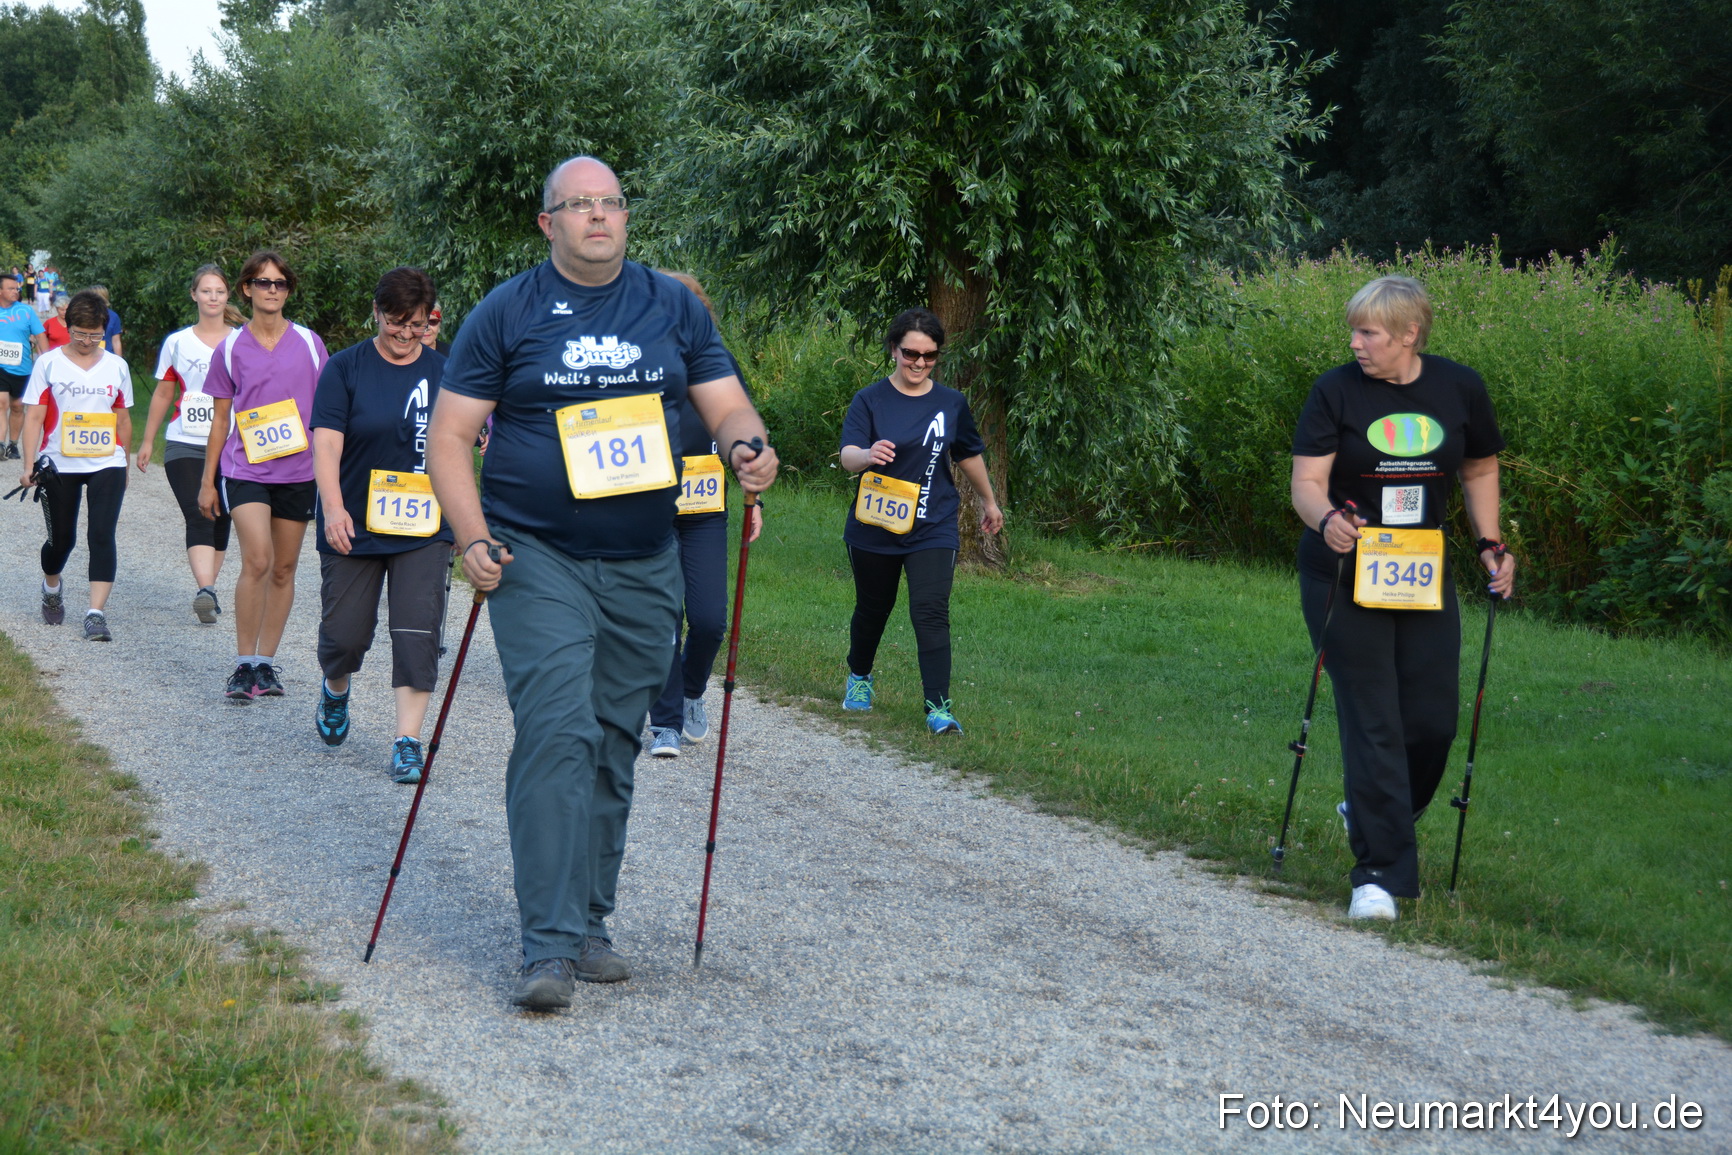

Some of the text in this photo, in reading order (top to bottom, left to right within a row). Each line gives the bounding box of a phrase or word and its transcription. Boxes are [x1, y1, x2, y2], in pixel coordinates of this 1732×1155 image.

[563, 339, 641, 370] Burgis
[59, 381, 113, 397] Xplus1
[544, 367, 664, 388] Weil's guad is!
[68, 430, 111, 445] 1506
[254, 423, 292, 447] 306
[588, 435, 647, 470] 181
[916, 440, 944, 519] RAIL.ONE
[376, 496, 431, 520] 1151
[864, 493, 909, 520] 1150
[1366, 560, 1433, 587] 1349
